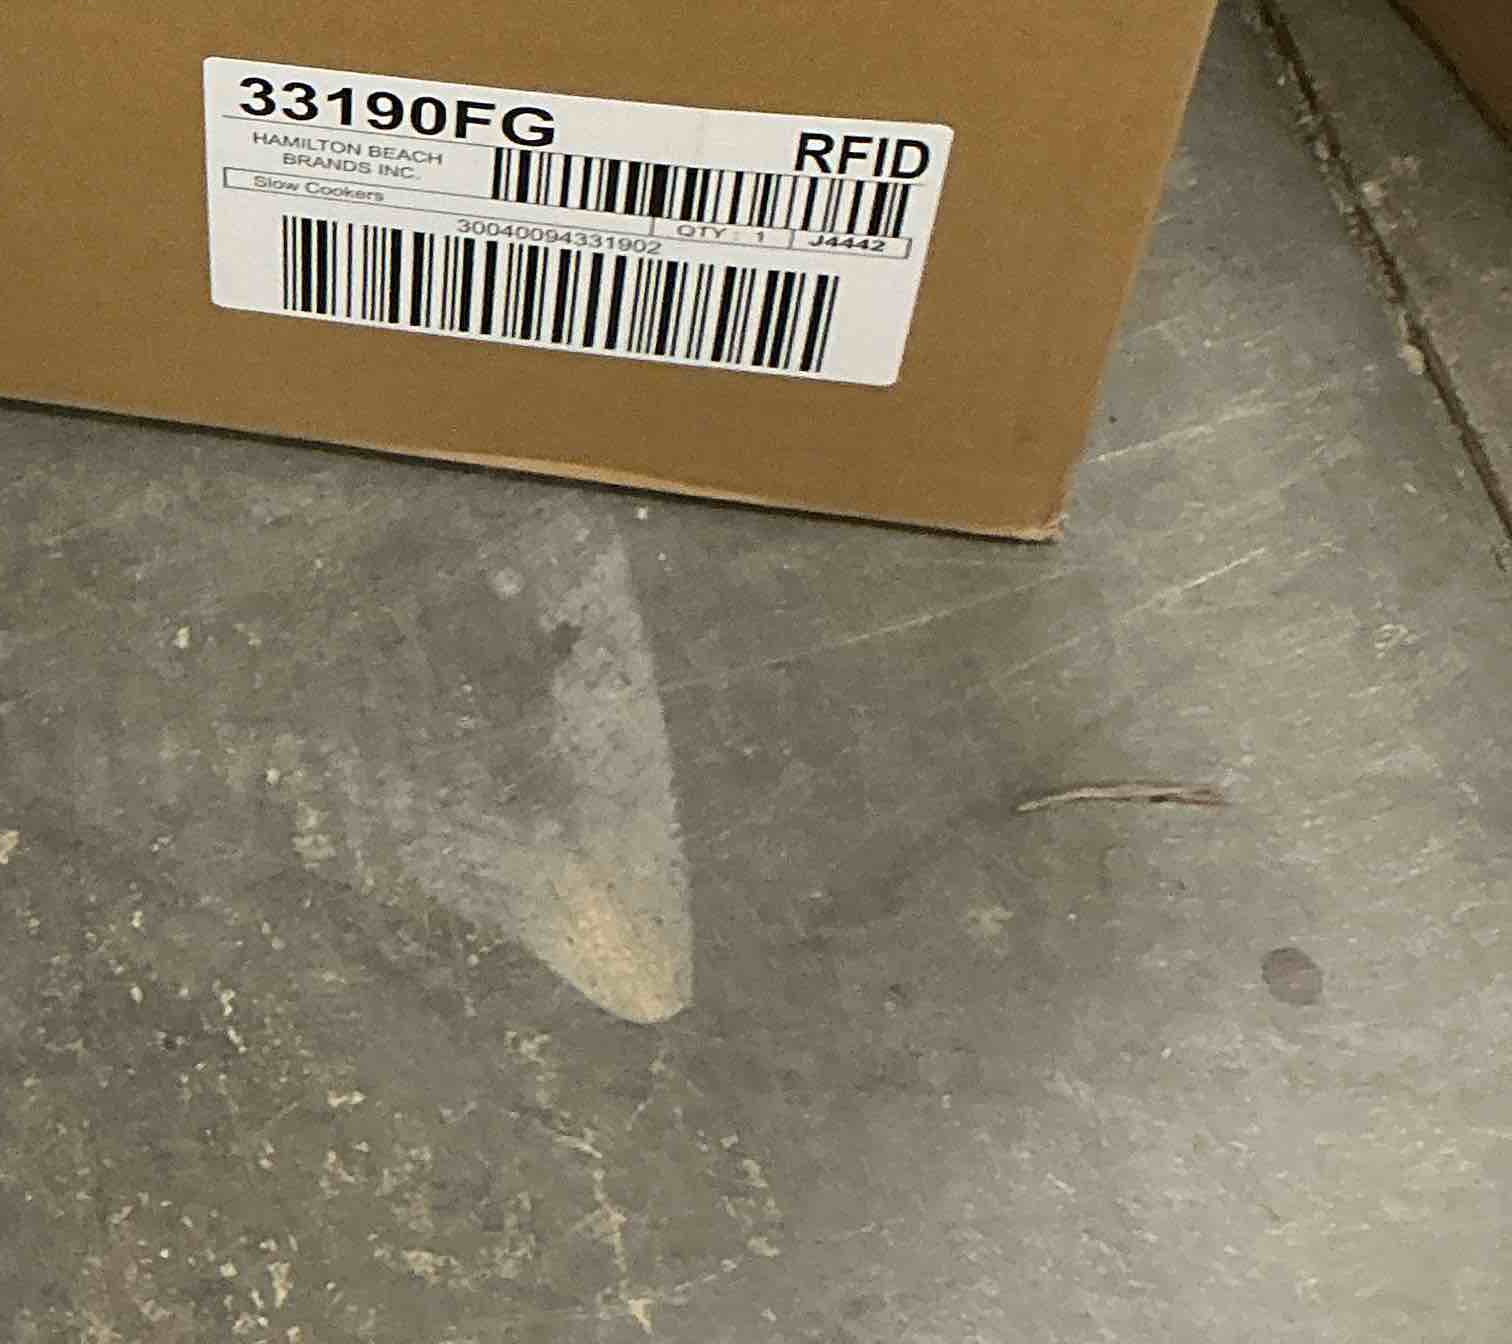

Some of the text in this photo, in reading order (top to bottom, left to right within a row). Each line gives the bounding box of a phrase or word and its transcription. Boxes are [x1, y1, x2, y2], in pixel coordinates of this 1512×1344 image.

[239, 77, 930, 179] 33190FG RFID
[252, 131, 444, 166] HAMILTON BEACH
[282, 153, 422, 180] BRANDS INC.
[253, 175, 385, 202] Slow Cookers
[457, 218, 663, 255] 30040094331902
[755, 230, 765, 243] 1
[808, 234, 887, 253] J4442
